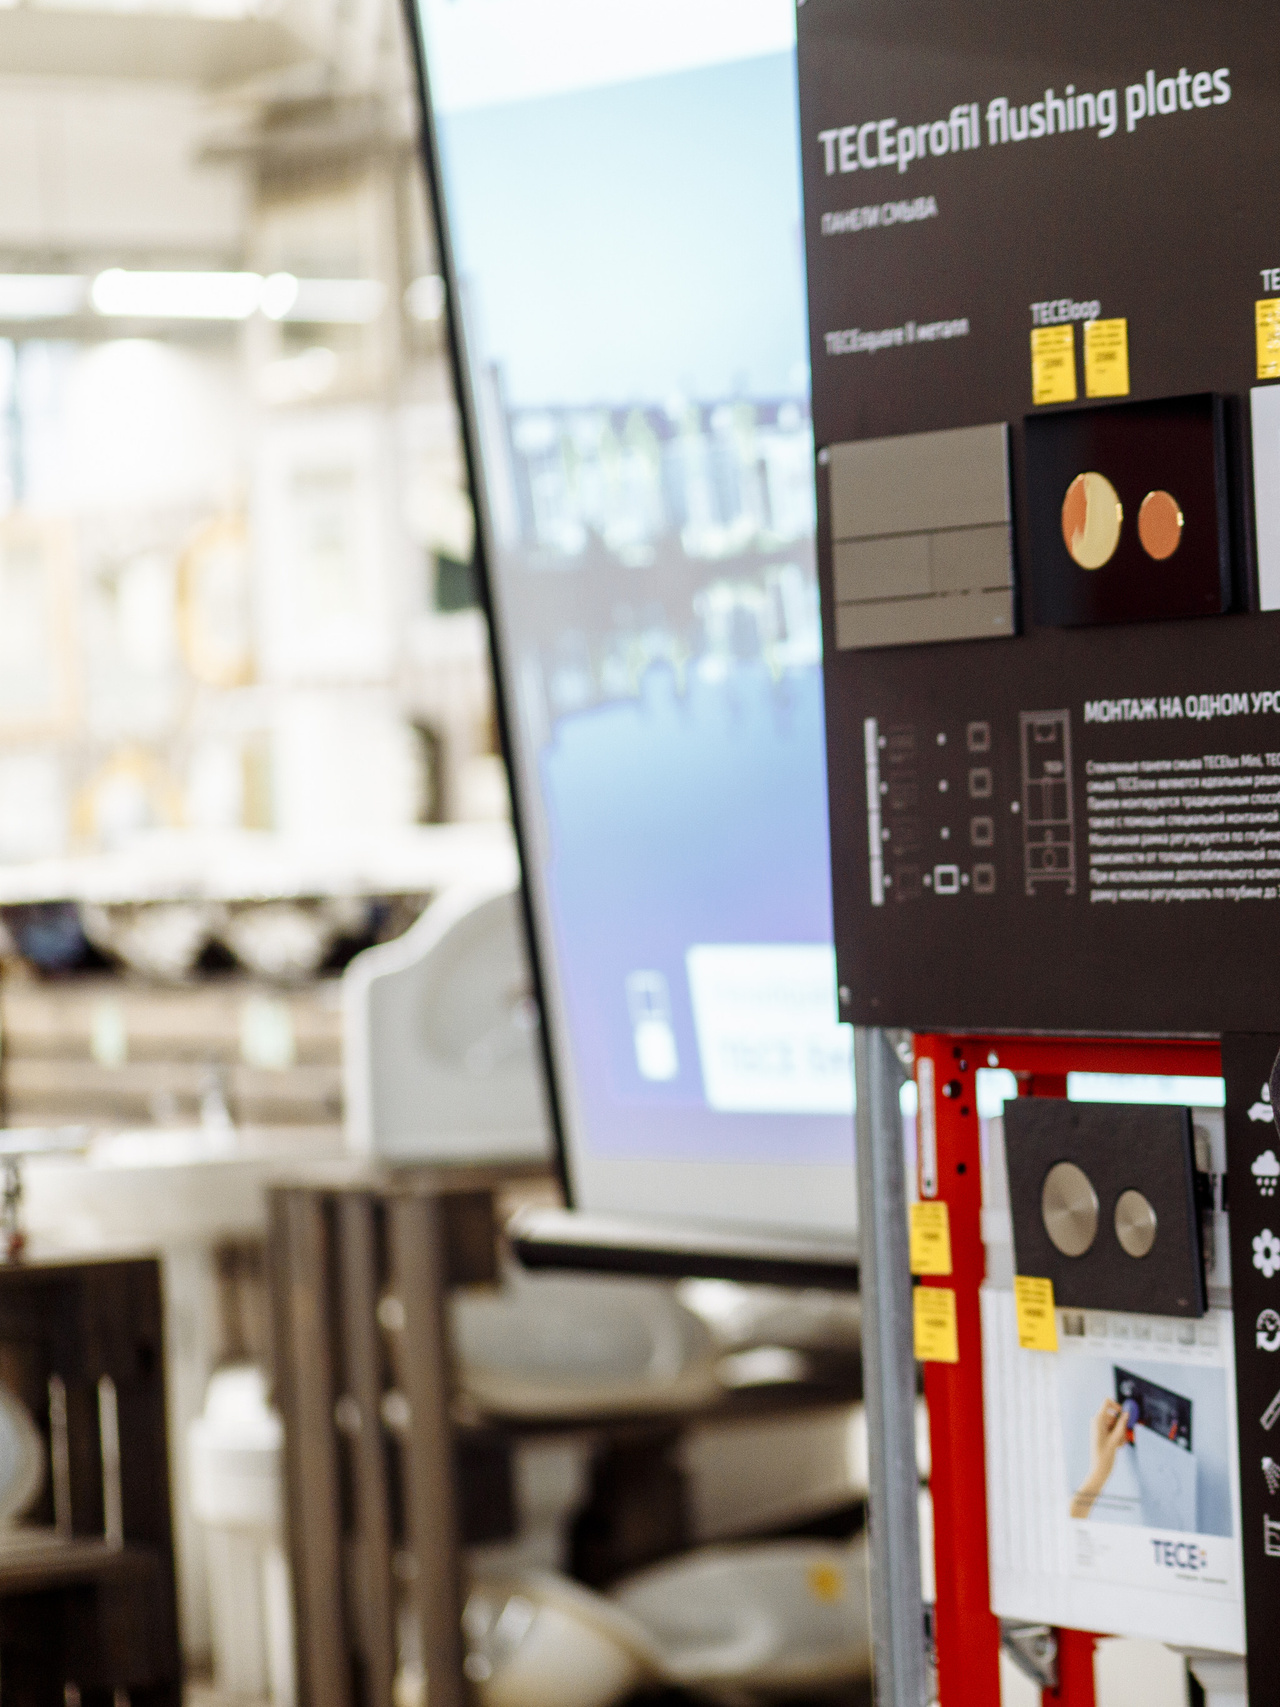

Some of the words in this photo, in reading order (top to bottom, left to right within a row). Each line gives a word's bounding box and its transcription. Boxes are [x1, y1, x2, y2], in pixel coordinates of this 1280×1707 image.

[818, 102, 981, 175] TECEprofil
[985, 84, 1117, 146] flushing
[1125, 67, 1232, 132] plates
[1030, 298, 1101, 325] TECEloop
[1084, 699, 1158, 722] МОНТАЖ
[1159, 697, 1183, 717] НА
[1185, 693, 1249, 719] ОДНОМ
